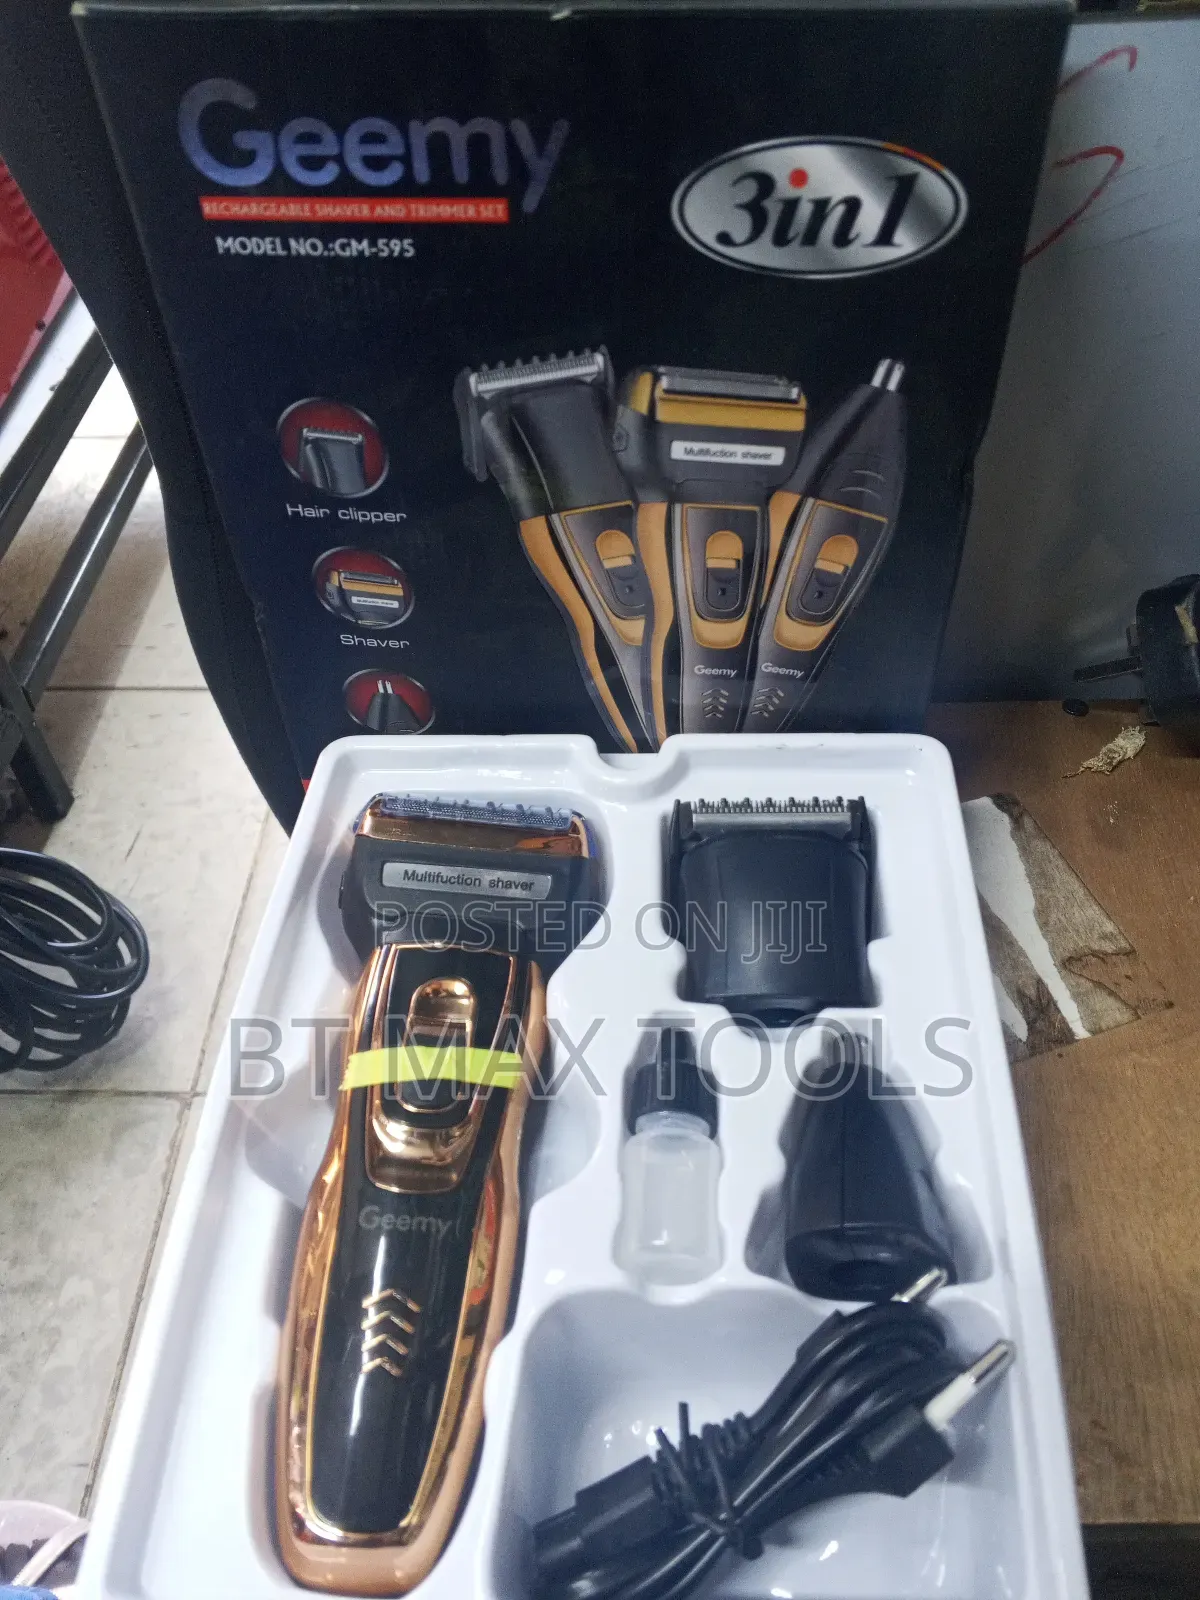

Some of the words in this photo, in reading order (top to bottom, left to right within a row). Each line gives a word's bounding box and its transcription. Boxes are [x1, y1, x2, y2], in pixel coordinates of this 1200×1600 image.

[177, 78, 570, 213] Geemy
[202, 202, 310, 217] RECHARGEABLE
[315, 203, 371, 218] SHAVER
[374, 204, 406, 218] AND
[408, 203, 476, 219] TRIMMER
[478, 204, 505, 219] SET
[215, 236, 287, 256] MODEL
[741, 450, 773, 460] shaver
[286, 503, 330, 519] Hair
[338, 507, 407, 524] clipper
[340, 634, 410, 649] Shaver
[694, 664, 738, 679] Geemy
[761, 662, 804, 679] Geemy
[403, 869, 481, 888] Multifuction
[489, 877, 535, 892] shaver
[360, 1204, 452, 1241] Geemy
